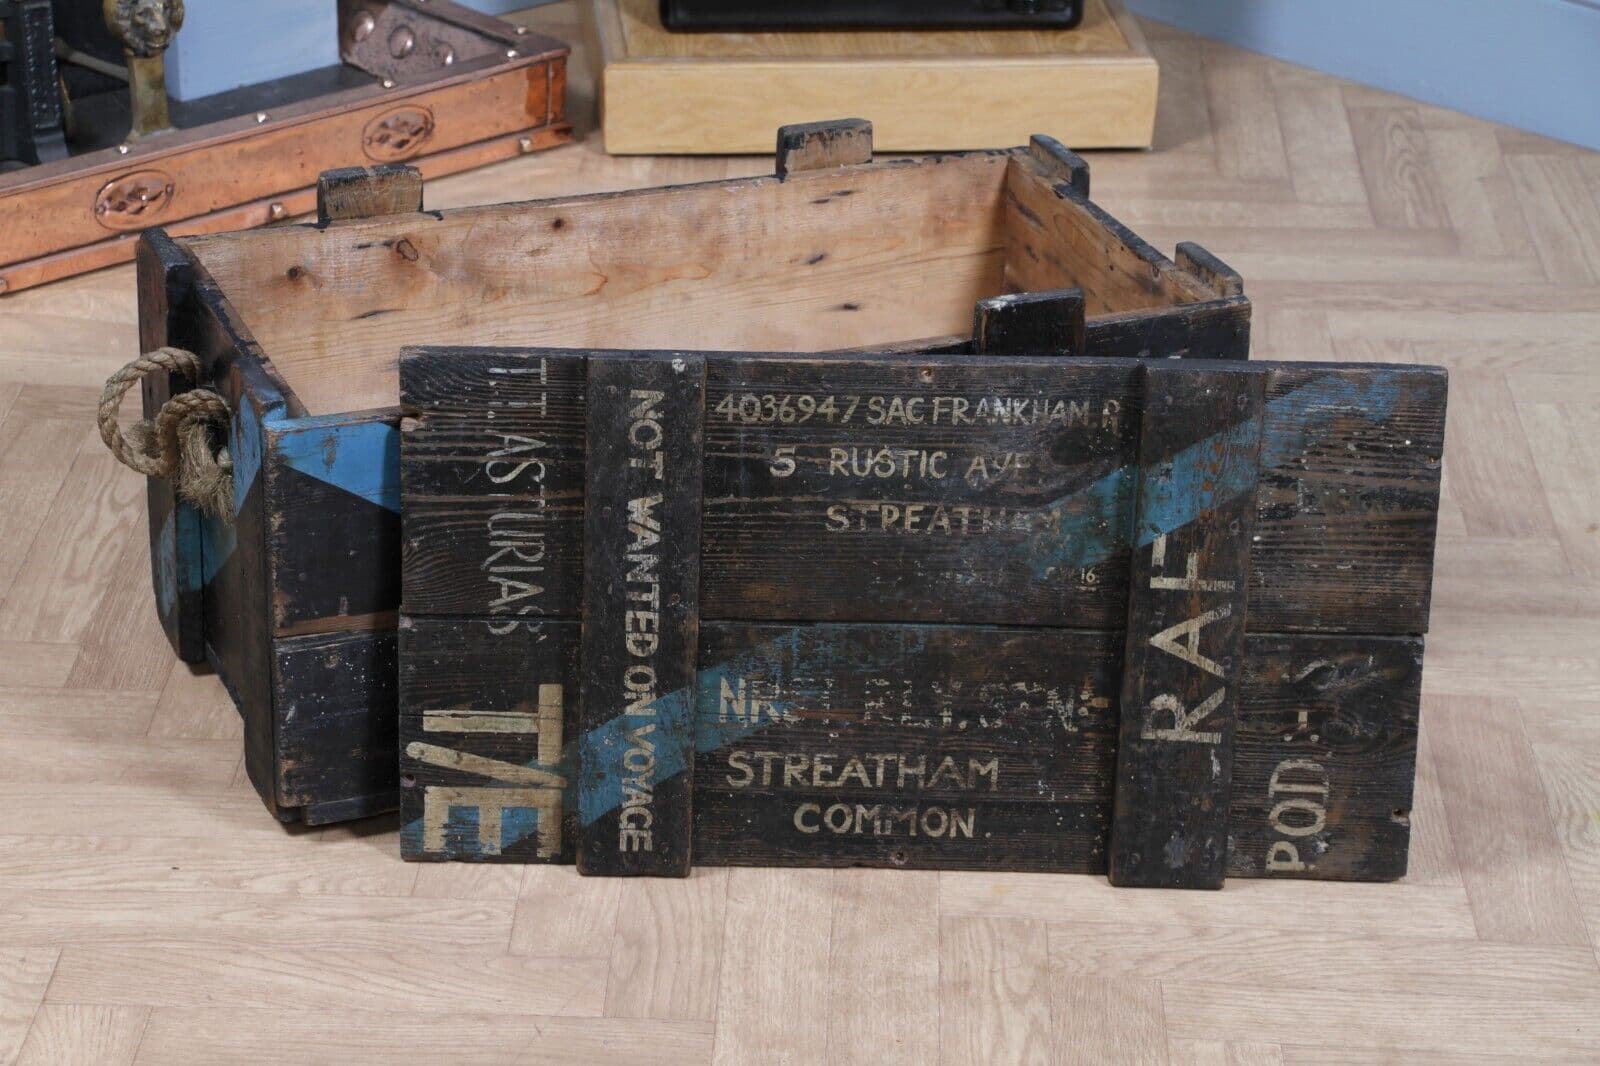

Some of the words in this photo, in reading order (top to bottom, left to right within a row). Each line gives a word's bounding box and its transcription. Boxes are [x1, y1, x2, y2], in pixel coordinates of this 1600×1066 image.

[627, 388, 665, 480] NOT
[714, 393, 861, 425] 4036947
[866, 395, 926, 426] SAC
[768, 446, 796, 478] 5
[829, 445, 948, 479] RUSTIC
[624, 492, 664, 658] WANTED
[1141, 533, 1237, 745] RAF
[622, 664, 657, 716] ON
[618, 723, 656, 853] VOYAGE
[725, 751, 999, 792] STREATHAM
